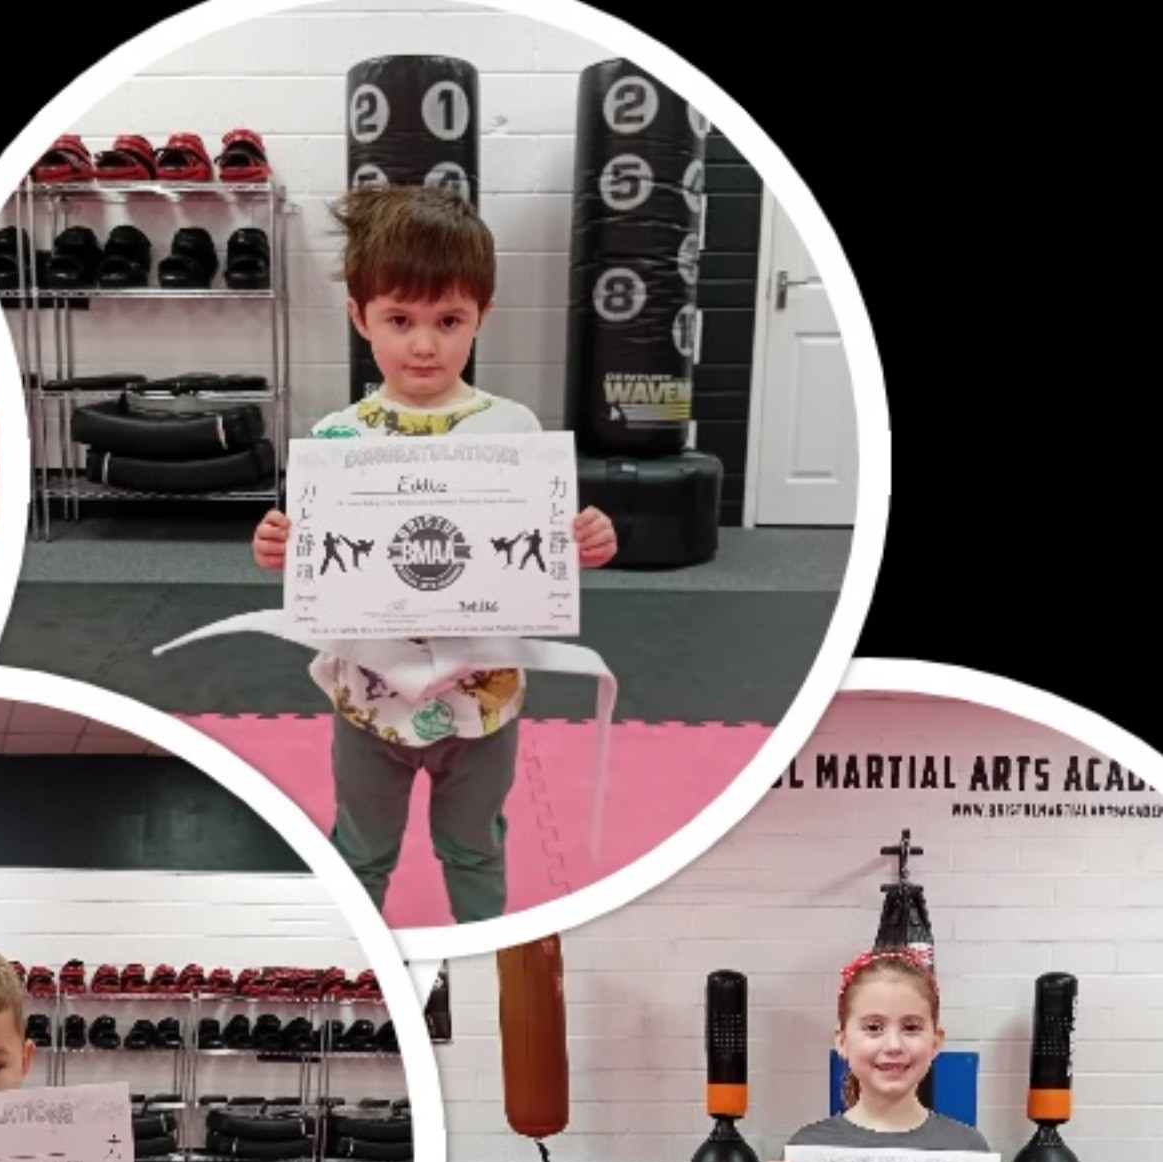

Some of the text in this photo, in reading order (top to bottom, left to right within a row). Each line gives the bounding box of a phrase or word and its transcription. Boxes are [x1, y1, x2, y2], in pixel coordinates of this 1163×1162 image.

[355, 89, 456, 134] 2 1
[613, 83, 645, 125] 2
[610, 161, 642, 202] 5
[603, 276, 636, 312] 8
[816, 754, 956, 789] MARTIAL
[968, 755, 1050, 791] ARTS
[1063, 756, 1155, 791] ACAD
